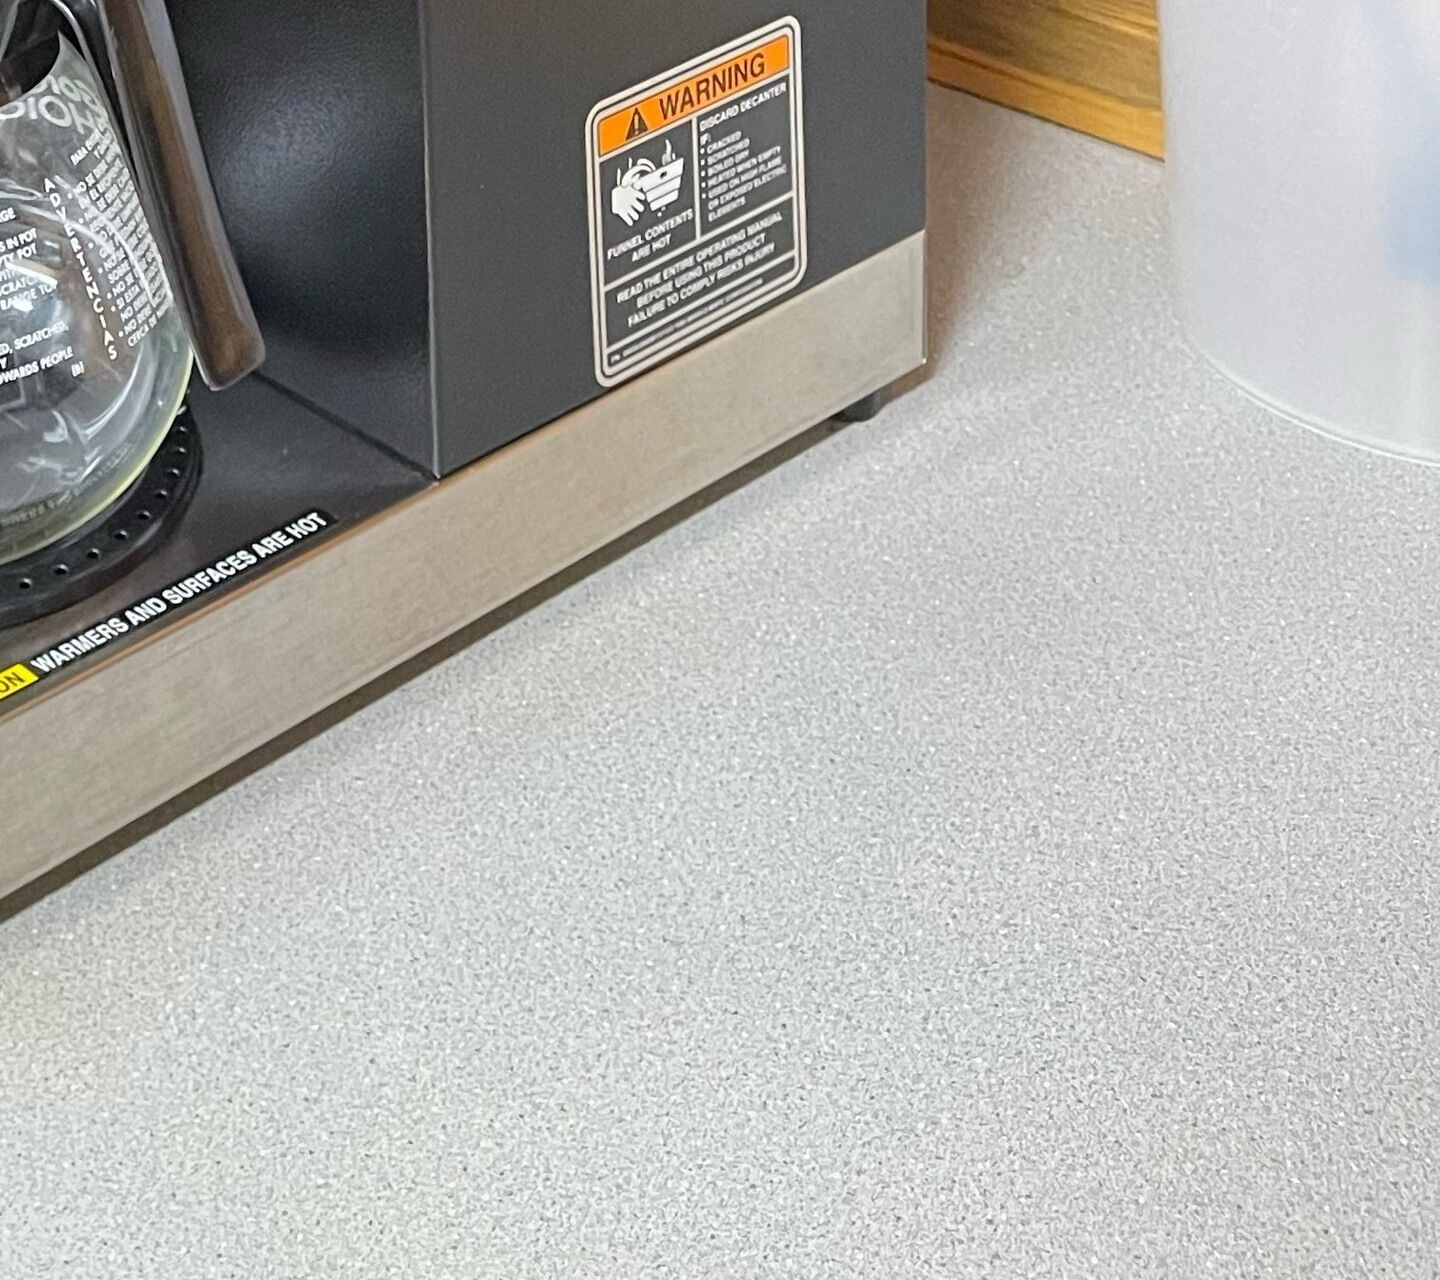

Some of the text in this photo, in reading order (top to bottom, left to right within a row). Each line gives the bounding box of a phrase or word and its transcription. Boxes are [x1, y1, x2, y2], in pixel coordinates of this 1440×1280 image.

[659, 53, 765, 120] WARNING
[6, 235, 18, 250] IN
[19, 228, 36, 244] POT
[17, 243, 36, 259] POT
[31, 617, 129, 673] WARMERS
[126, 597, 167, 626] AND
[162, 551, 253, 603] SURFACES
[253, 532, 294, 559] ARE
[286, 512, 328, 541] HOT
